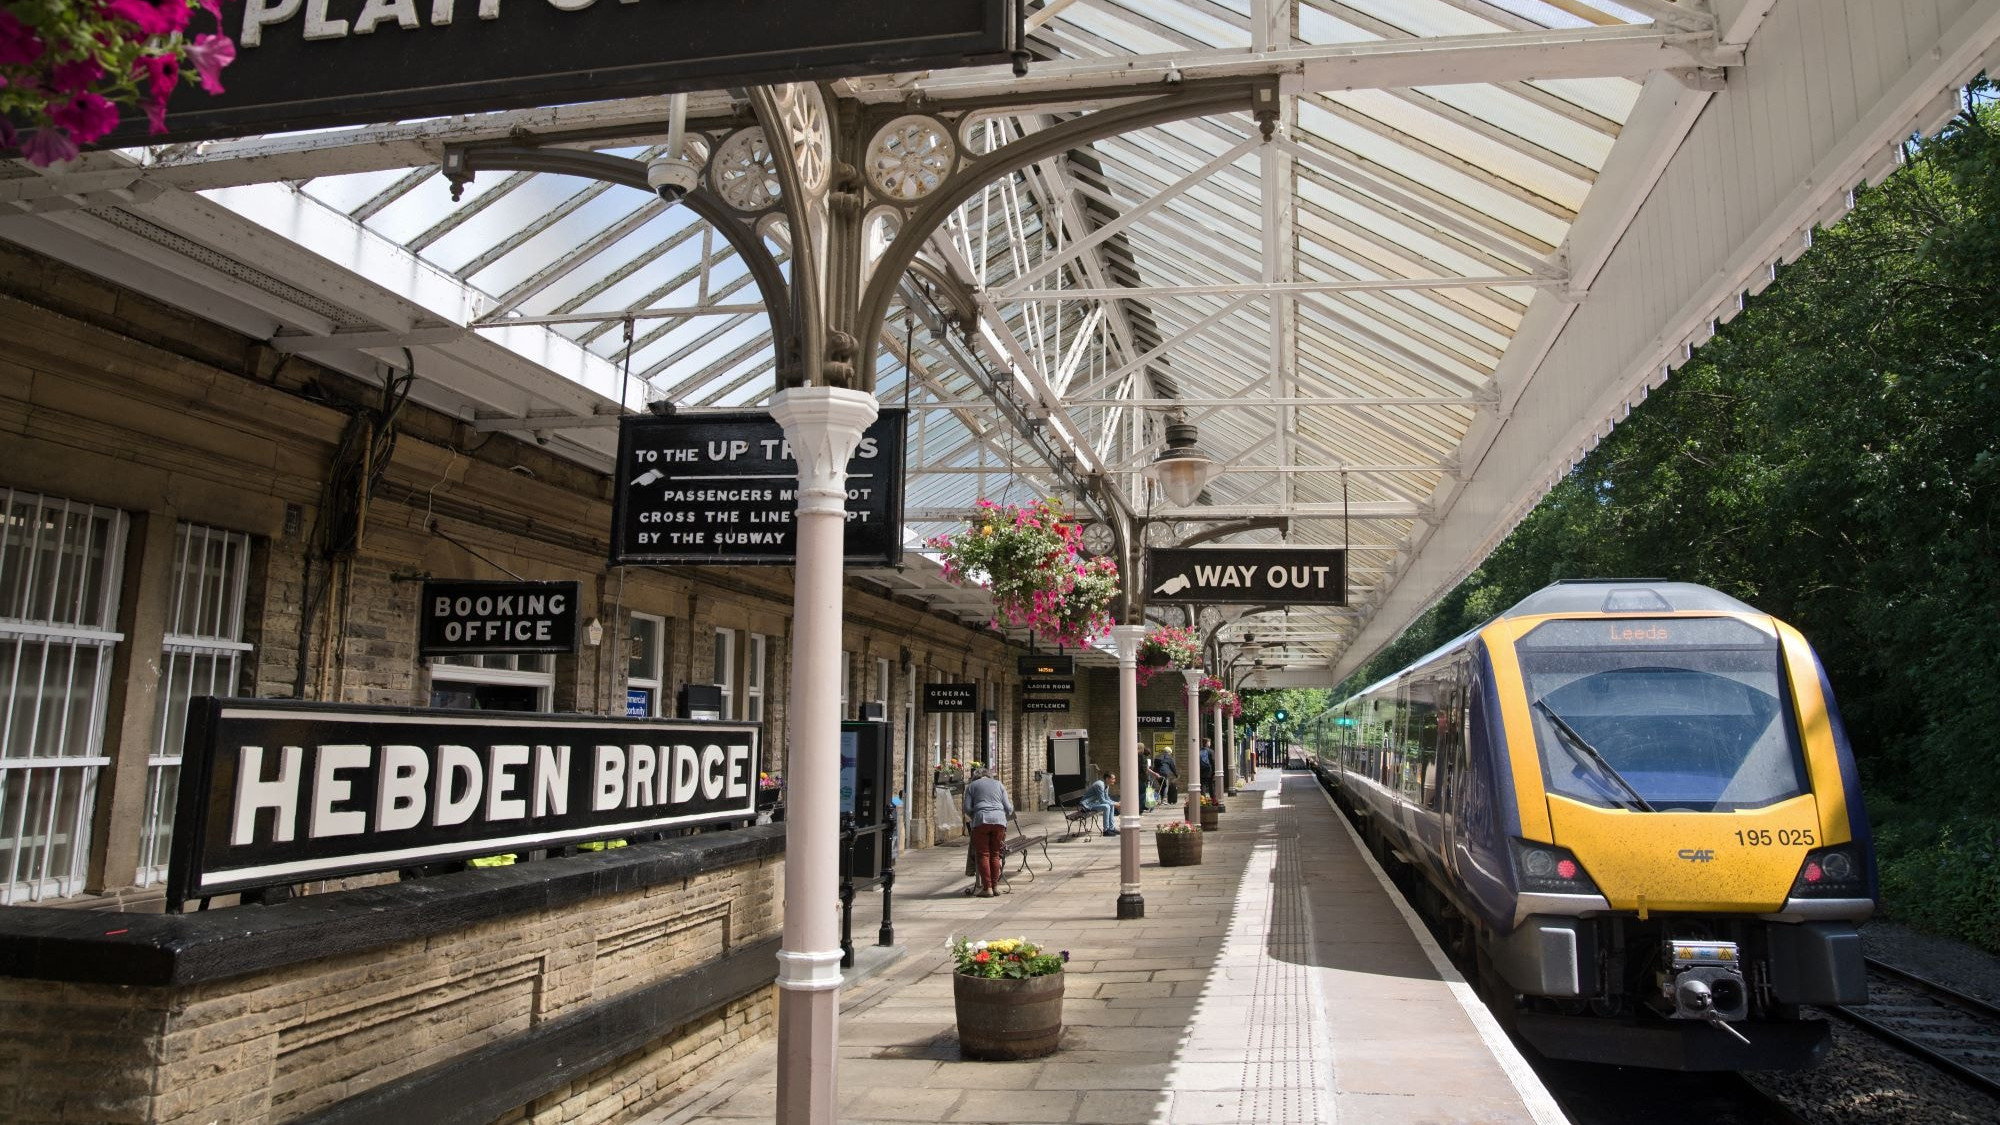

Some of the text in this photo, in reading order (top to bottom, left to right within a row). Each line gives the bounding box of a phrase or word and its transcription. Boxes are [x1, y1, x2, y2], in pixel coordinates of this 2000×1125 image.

[635, 449, 658, 463] TO
[663, 448, 699, 462] THE
[707, 440, 750, 461] UP
[664, 489, 772, 502] PASSENGERS
[639, 511, 790, 523] CROSS THE LINE
[638, 532, 786, 545] BY THE SUBWAY
[1194, 565, 1330, 588] WAY OUT
[434, 594, 566, 617] BOOKING
[444, 620, 552, 642] OFFICE
[1610, 624, 1668, 640] Leeds
[231, 744, 749, 846] HEBDEN BRIDGE
[1735, 829, 1815, 846] 195 025
[1678, 849, 1714, 862] CAF
